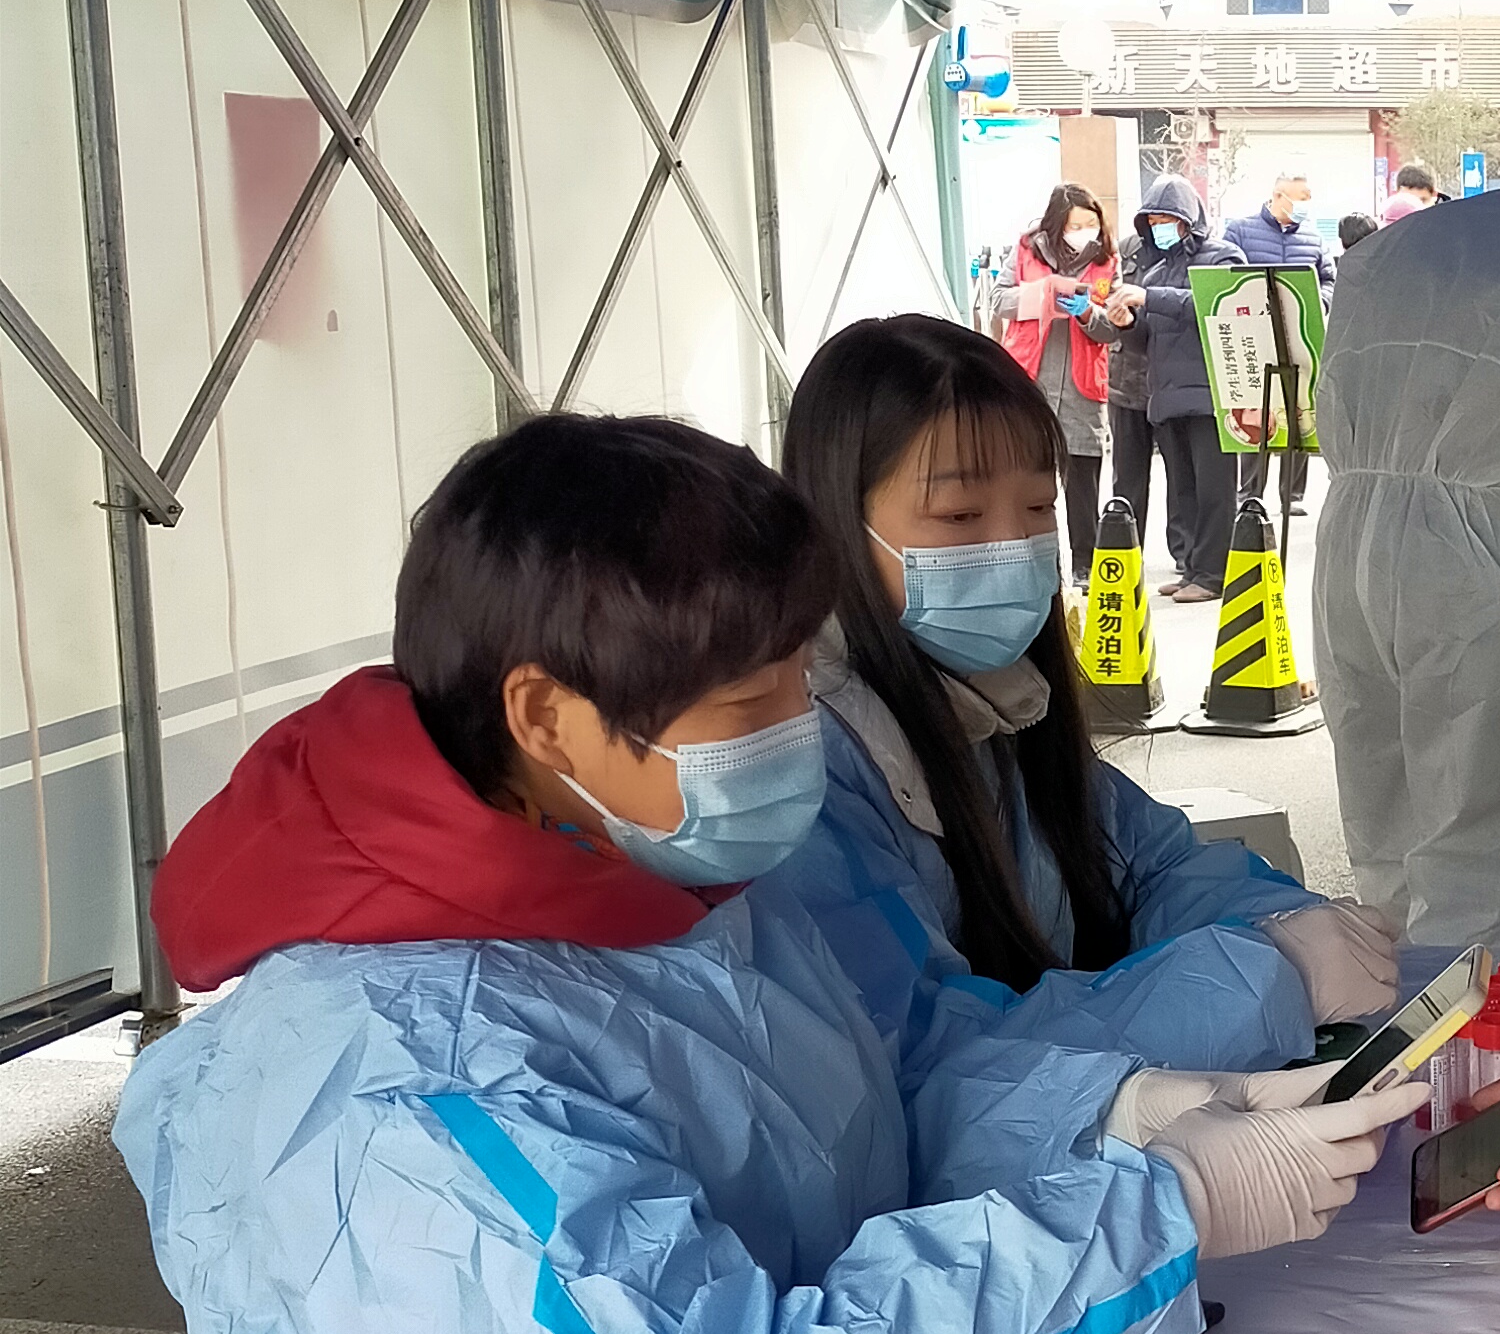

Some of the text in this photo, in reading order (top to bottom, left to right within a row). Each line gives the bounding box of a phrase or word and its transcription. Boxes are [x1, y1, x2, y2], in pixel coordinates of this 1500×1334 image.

[1092, 43, 1462, 95] 新天地超市
[1241, 335, 1262, 390] 接种疫苗
[1096, 592, 1125, 677] 请勿泊车
[1270, 592, 1291, 676] 请勿泊车
